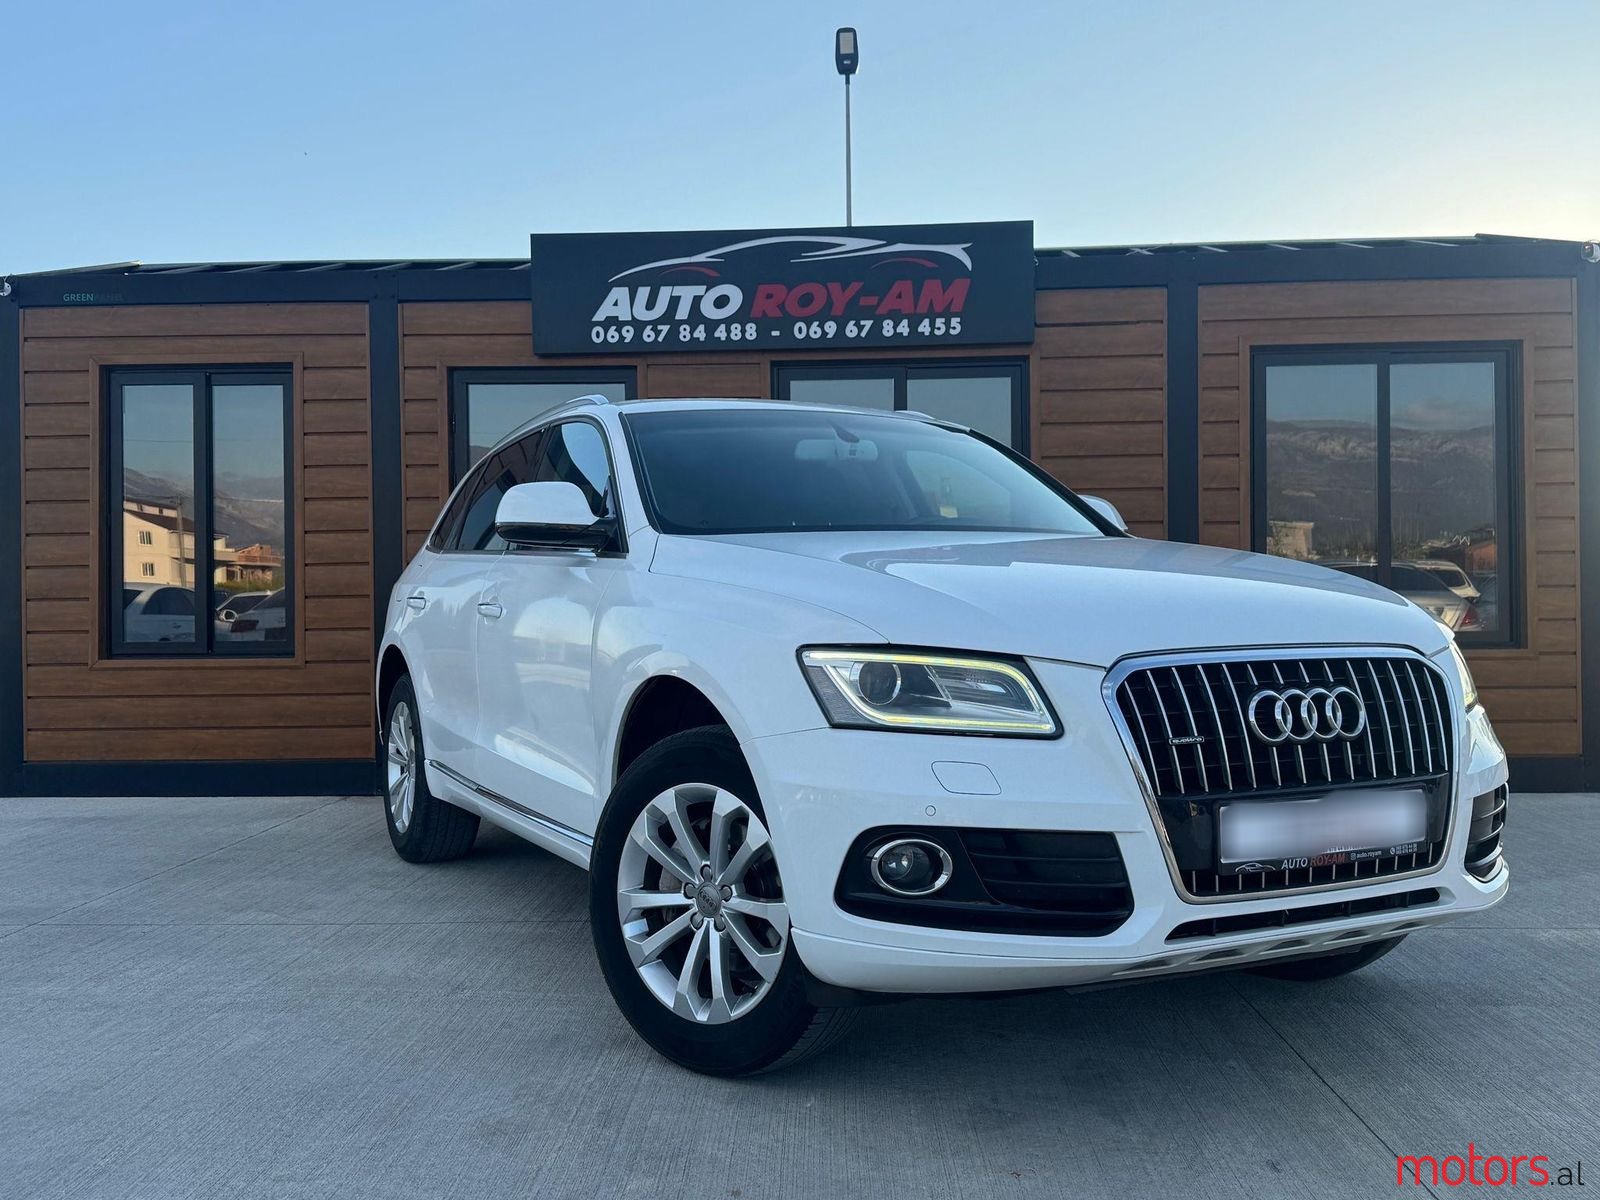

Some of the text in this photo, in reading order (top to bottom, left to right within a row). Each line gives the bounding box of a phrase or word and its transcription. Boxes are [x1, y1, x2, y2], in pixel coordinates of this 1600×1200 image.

[63, 293, 94, 302] GREEN
[591, 278, 971, 321] AUTO ROY-AM
[591, 325, 635, 344] 069
[642, 324, 671, 343] 67
[679, 323, 707, 342] 84
[714, 322, 758, 342] 488
[793, 320, 838, 339] 069
[845, 319, 874, 338] 67
[881, 318, 910, 337] 84
[917, 317, 962, 336] 455
[1281, 857, 1308, 870] AUTO
[1310, 853, 1345, 867] ROY-AM
